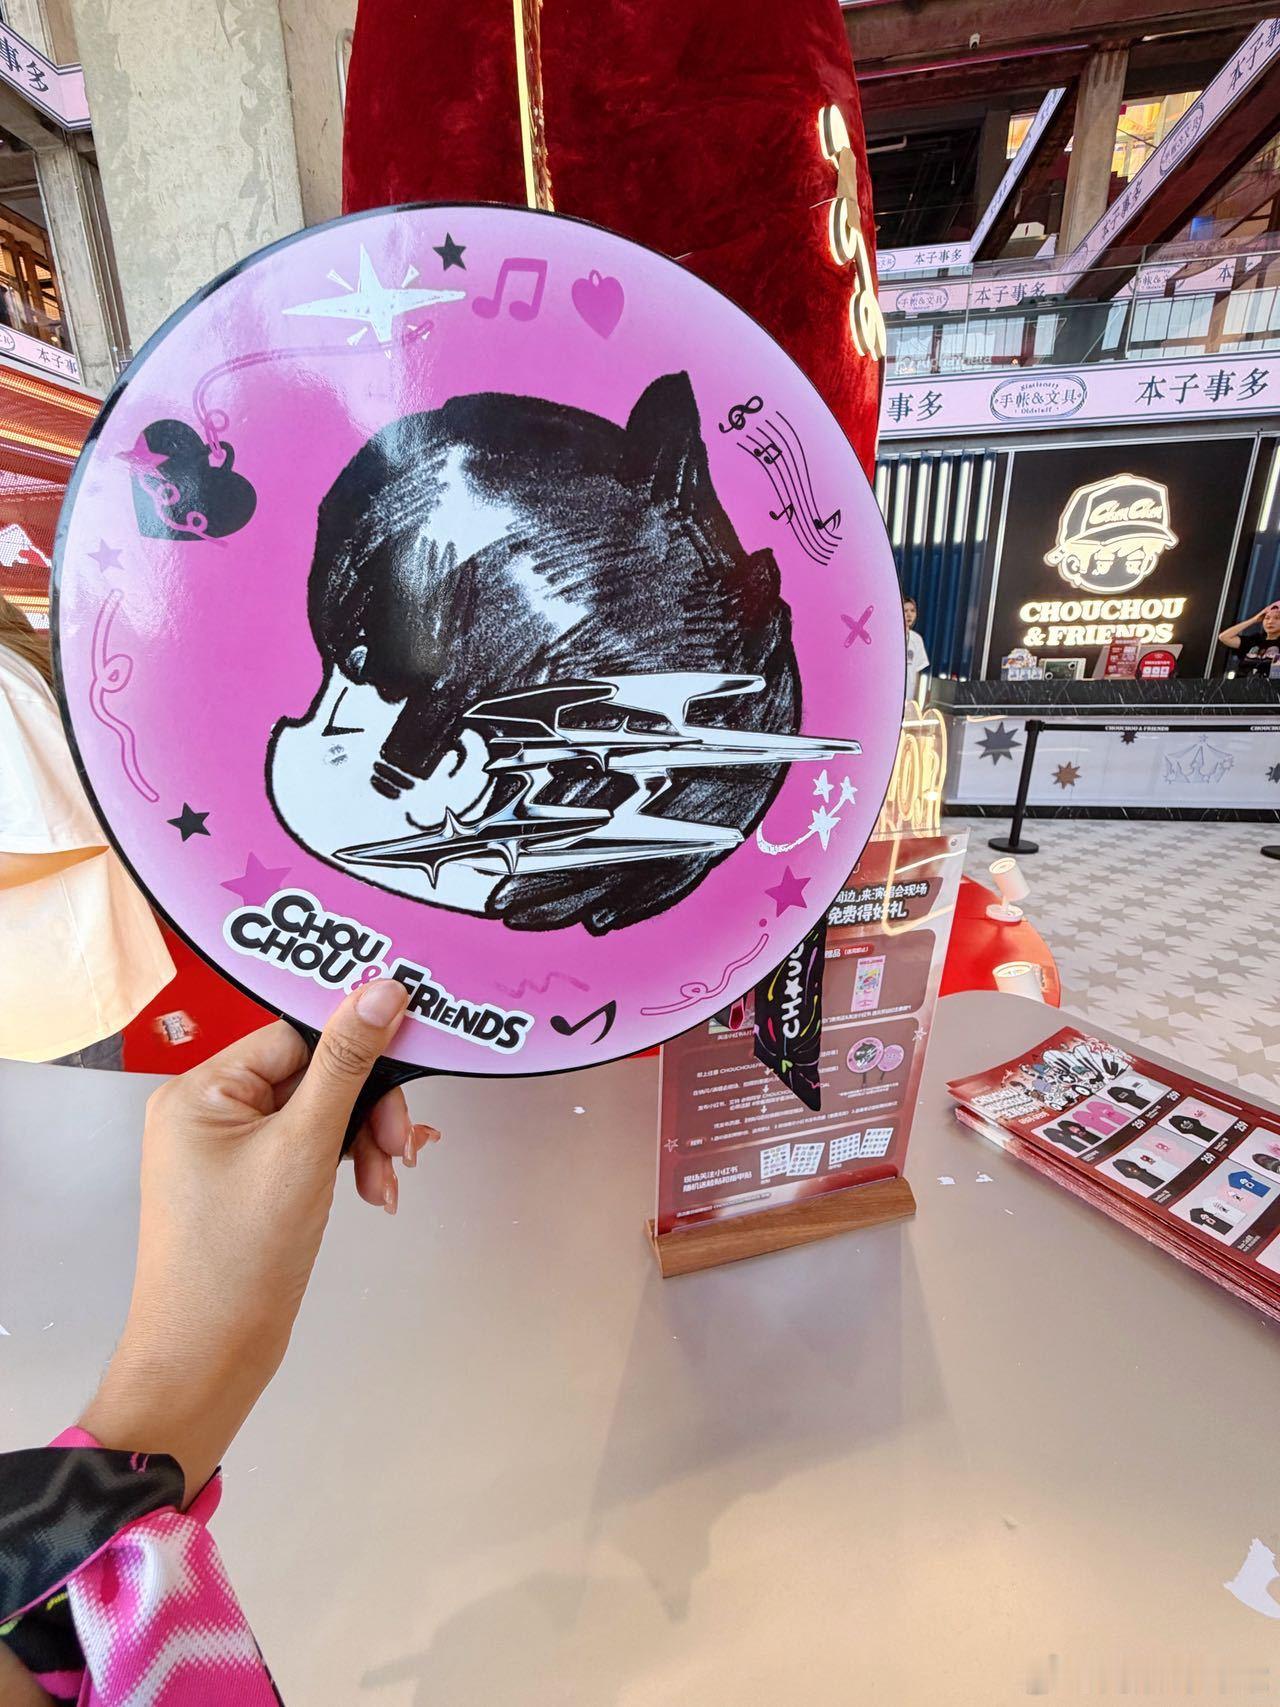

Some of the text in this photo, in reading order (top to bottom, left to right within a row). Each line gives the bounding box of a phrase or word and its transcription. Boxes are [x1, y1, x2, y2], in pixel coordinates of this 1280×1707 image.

[914, 248, 962, 265] 本子事多
[999, 389, 1077, 409] 手帐&文具
[1135, 368, 1270, 406] 本子事多
[887, 391, 943, 423] 事多
[1019, 598, 1187, 623] CHOUCHOU
[1023, 624, 1174, 646] & FRIENDS
[271, 894, 385, 963] CHOU
[230, 912, 357, 984] CHOU
[392, 963, 529, 1049] FRIENDS
